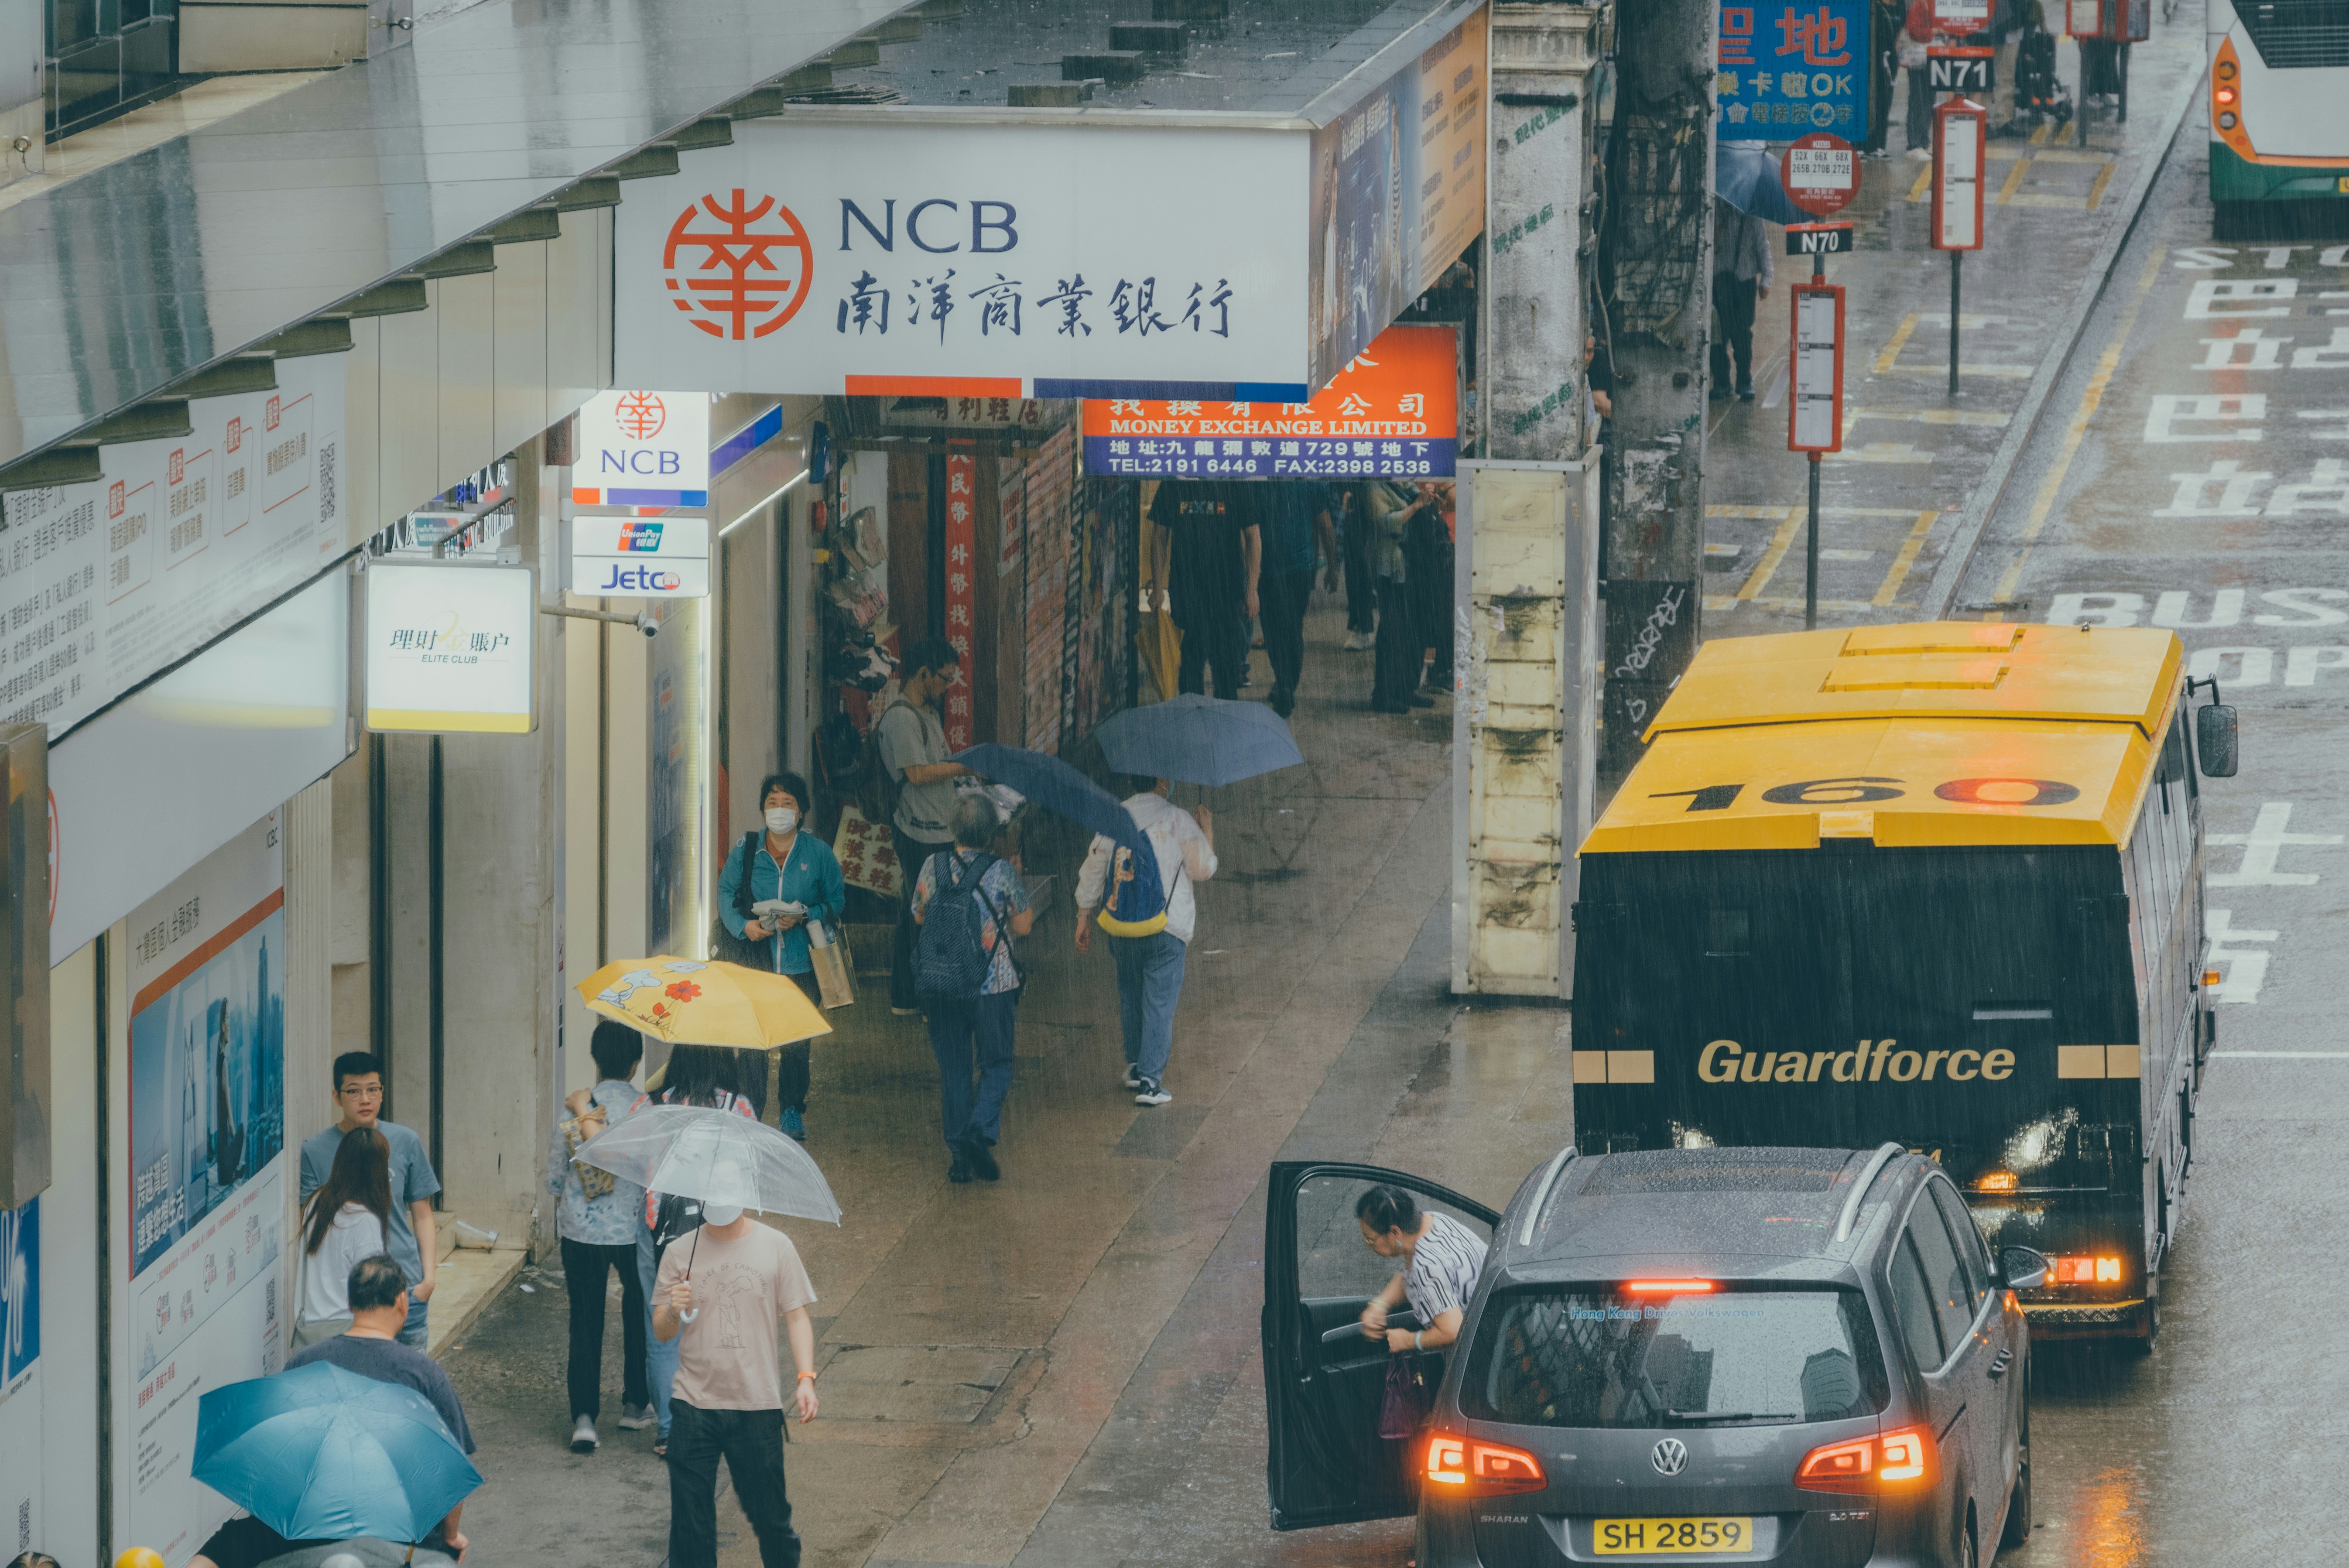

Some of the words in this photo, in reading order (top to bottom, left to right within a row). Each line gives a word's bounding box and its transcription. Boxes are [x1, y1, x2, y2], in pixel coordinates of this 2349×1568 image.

[1931, 60, 1986, 87] N71
[1795, 151, 1808, 161] 52X
[1815, 151, 1828, 161] 66X
[1835, 152, 1849, 161] 68X
[1792, 164, 1810, 173] 265B
[1813, 164, 1830, 174] 270B
[1833, 164, 1851, 174] 272E
[839, 198, 1019, 253] NCB
[1802, 232, 1839, 253] N70
[837, 267, 1234, 348] 南洋商業銀行
[1111, 394, 1426, 418] 找換有限公司
[1110, 419, 1193, 435] MONEY
[1199, 420, 1324, 435] EXCHANGE
[1329, 420, 1427, 435] LIMITED
[601, 449, 680, 475] NCB
[1109, 459, 1199, 473] TEL:2191
[1207, 459, 1257, 473] 6446
[1275, 459, 1374, 474] FAX:2398
[1381, 460, 1431, 474] 2538
[483, 500, 515, 544] BUILDIN
[621, 528, 661, 541] UnionPay
[2046, 587, 2349, 627] BUS
[421, 654, 449, 663] ELITE
[451, 655, 478, 664] CLUB
[1648, 777, 2081, 813] 160
[267, 826, 278, 851] ICBC
[136, 895, 199, 969] 大灣區個人金融服務
[1698, 1038, 2016, 1083] Guardforce
[720, 1263, 729, 1272] DE
[1571, 1307, 1603, 1321] Hong
[1609, 1307, 1642, 1322] Kong
[1645, 1307, 1683, 1319] Drives
[1688, 1308, 1764, 1321] Volkswagen
[1480, 1515, 1528, 1523] SHARAN
[1603, 1524, 1644, 1549] SH
[1657, 1521, 1743, 1547] 2859
